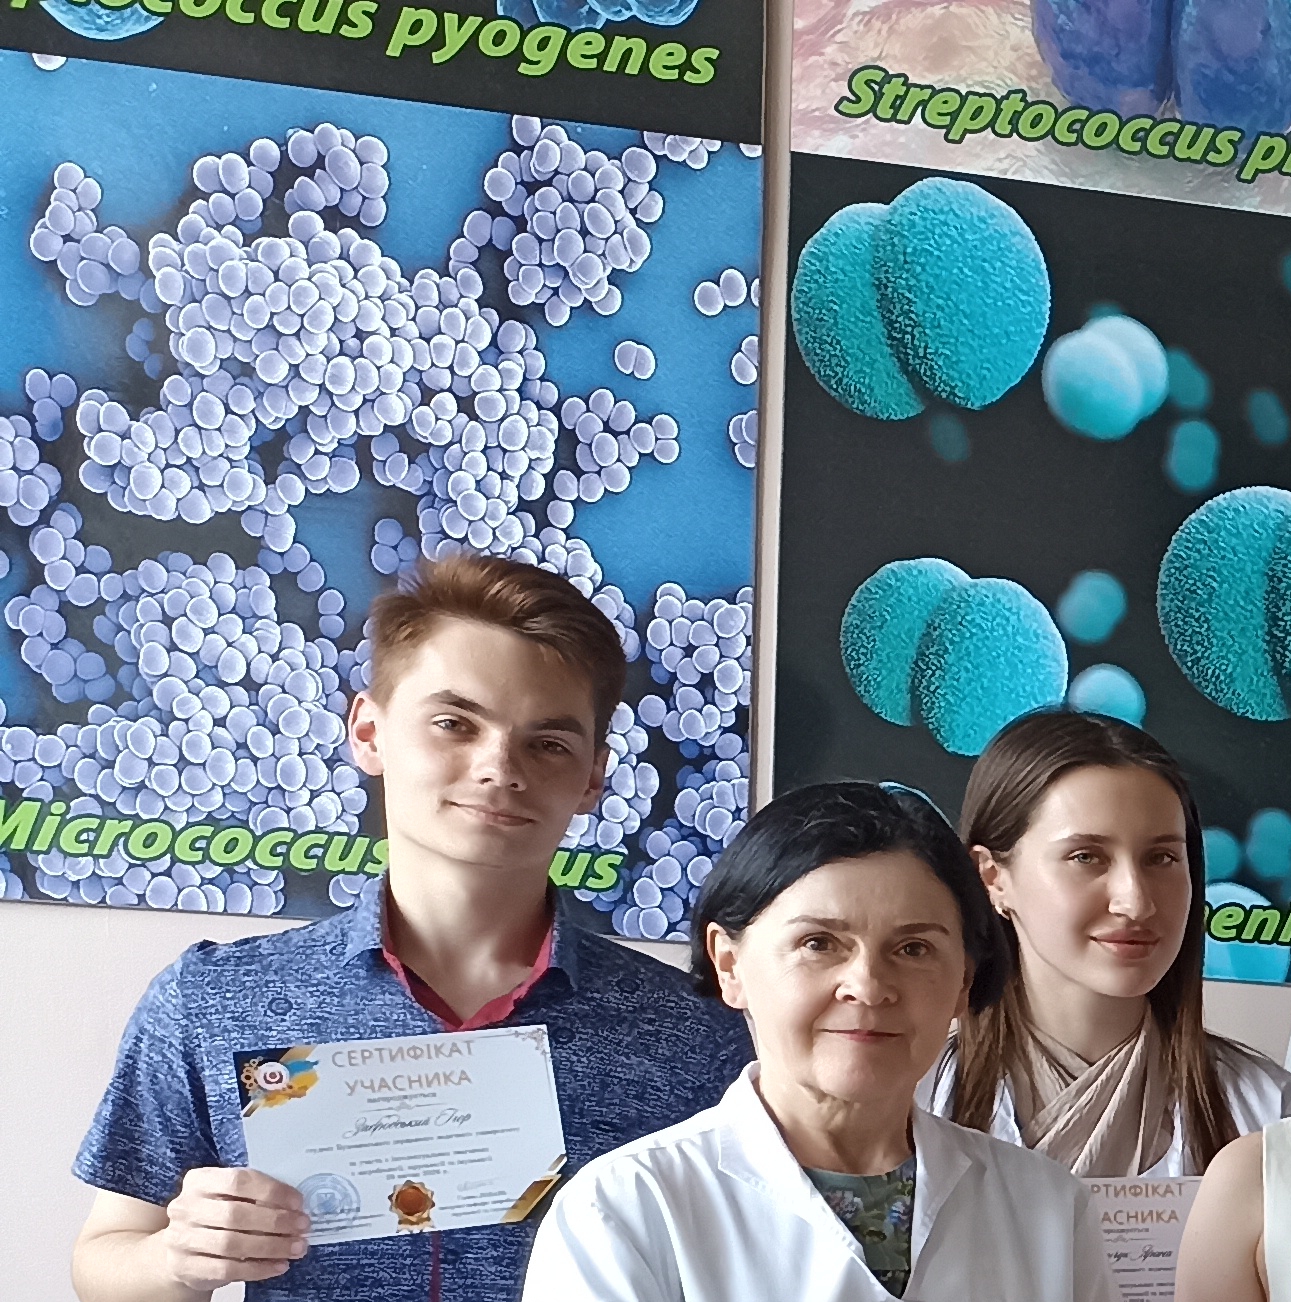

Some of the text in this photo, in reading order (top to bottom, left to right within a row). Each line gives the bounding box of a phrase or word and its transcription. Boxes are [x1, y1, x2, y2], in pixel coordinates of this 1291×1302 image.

[386, 6, 720, 84] pyogenes
[839, 68, 1240, 165] Streptococcus
[0, 799, 390, 873] Micrococcus
[331, 1039, 475, 1068] СЕРТИФІКАТ
[344, 1069, 473, 1096] УЧАСНИКА
[1090, 1182, 1185, 1199] РТИФІКАТ
[1101, 1209, 1180, 1226] АСНИКА
